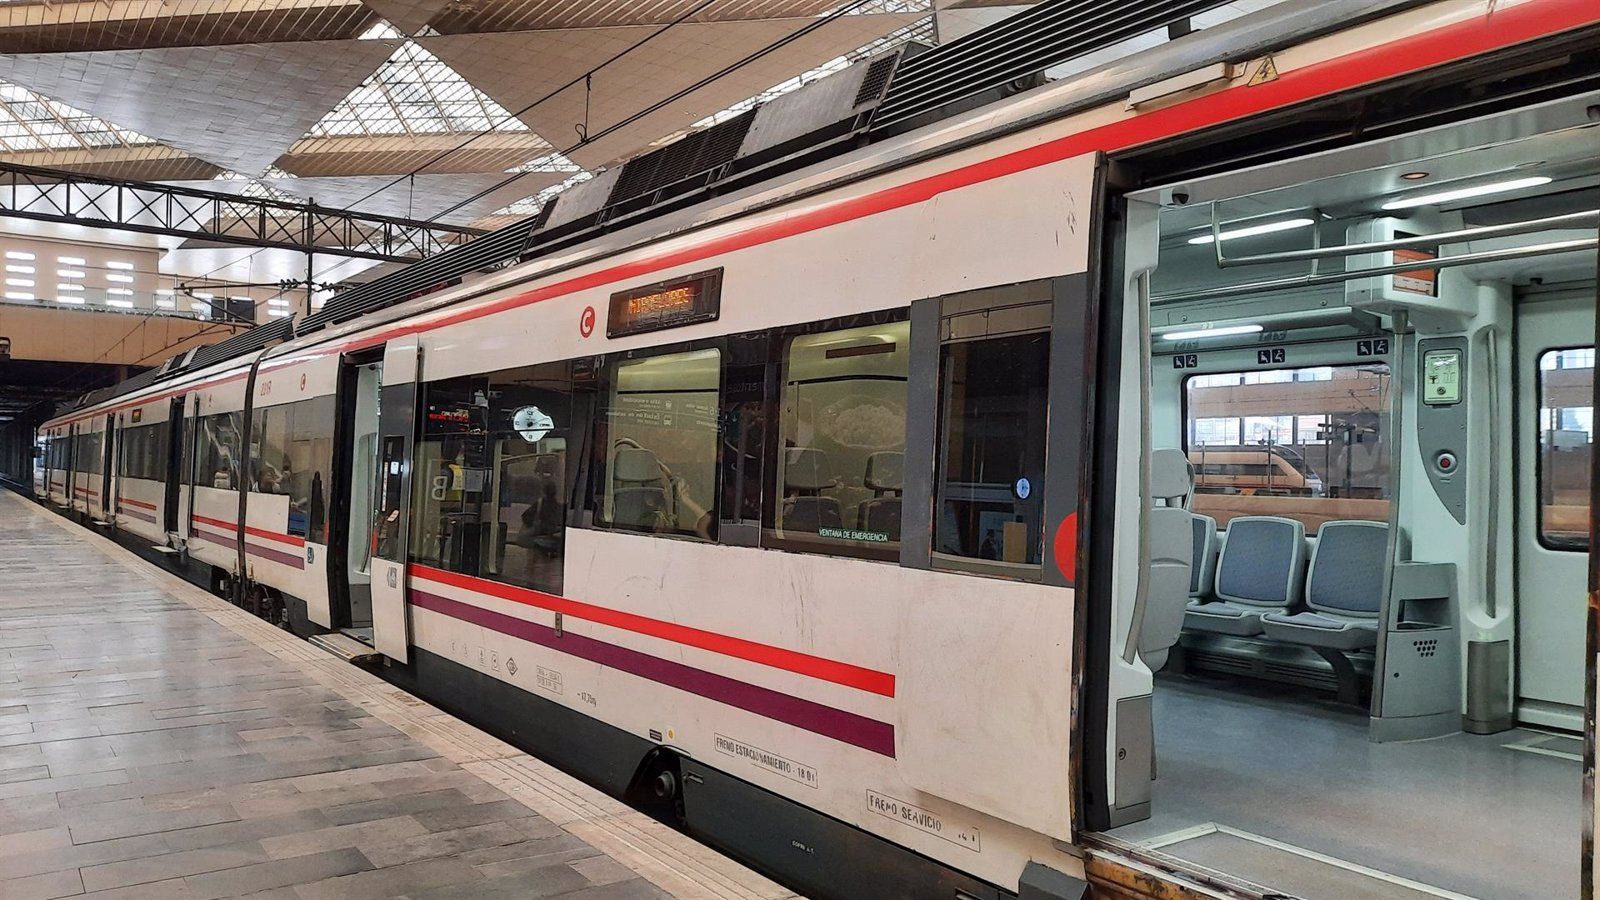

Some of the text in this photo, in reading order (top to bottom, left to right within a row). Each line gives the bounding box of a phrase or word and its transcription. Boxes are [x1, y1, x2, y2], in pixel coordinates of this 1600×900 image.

[819, 528, 888, 541] VENTANA DE EMERGENCIA
[716, 737, 735, 752] FRENO
[735, 744, 791, 773] ESTACIONAMIENTO
[901, 806, 942, 832] SERVICIO
